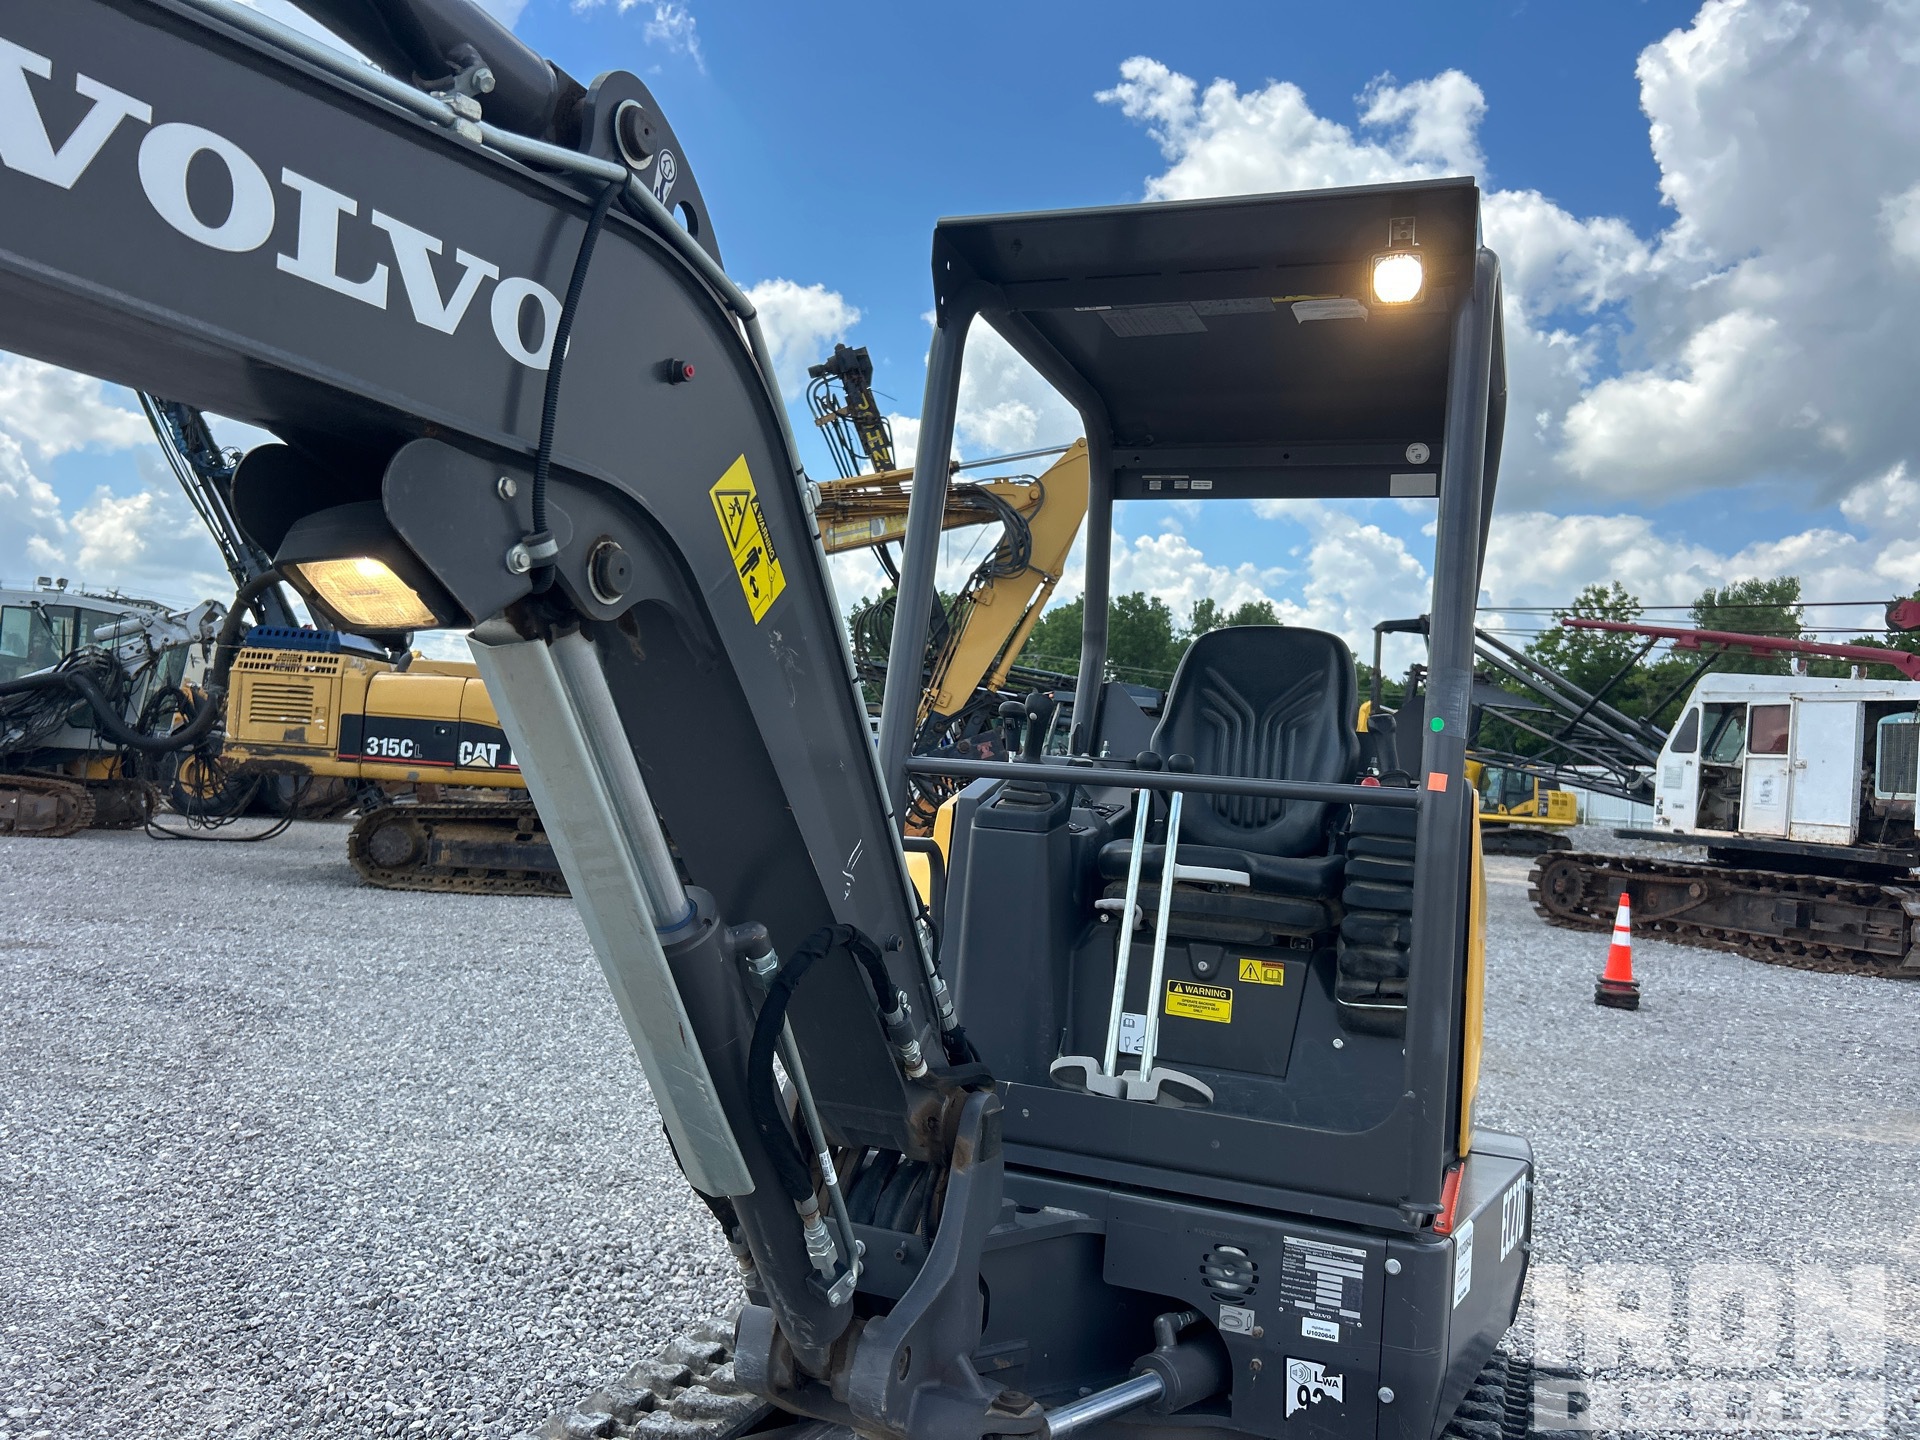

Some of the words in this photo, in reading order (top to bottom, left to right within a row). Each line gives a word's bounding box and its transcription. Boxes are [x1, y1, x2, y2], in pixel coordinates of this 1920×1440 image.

[0, 37, 570, 371] VOLVO
[757, 510, 775, 560] WARNING
[459, 741, 500, 768] CAT
[1185, 985, 1227, 998] WARNING
[1309, 1311, 1332, 1319] VOLVO
